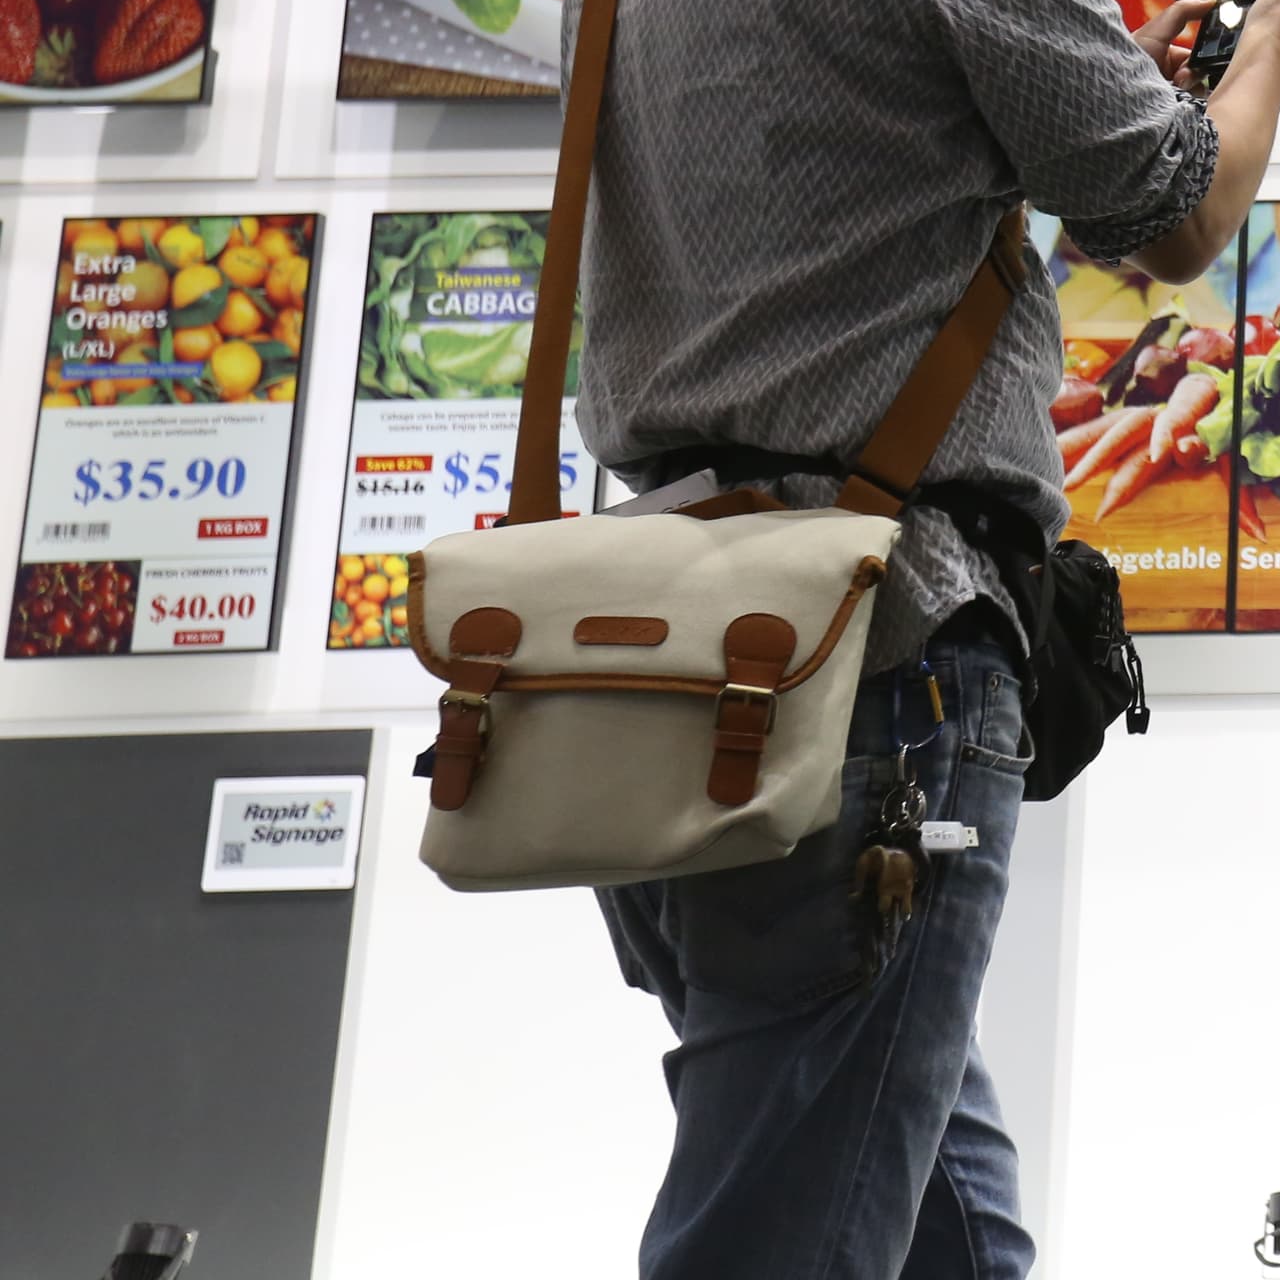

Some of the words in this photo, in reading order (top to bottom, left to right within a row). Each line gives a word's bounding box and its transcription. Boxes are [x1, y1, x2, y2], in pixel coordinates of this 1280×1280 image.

[74, 254, 136, 275] Extra
[437, 272, 521, 288] Taiwanese
[70, 280, 136, 305] Large
[427, 292, 535, 315] CABBAG
[66, 308, 168, 333] Oranges
[62, 340, 114, 360] (L/XL)
[74, 458, 246, 505] $35.90
[235, 520, 263, 534] BOX
[151, 594, 256, 623] $40.00
[243, 802, 311, 824] Rapid
[251, 825, 344, 846] Signage
